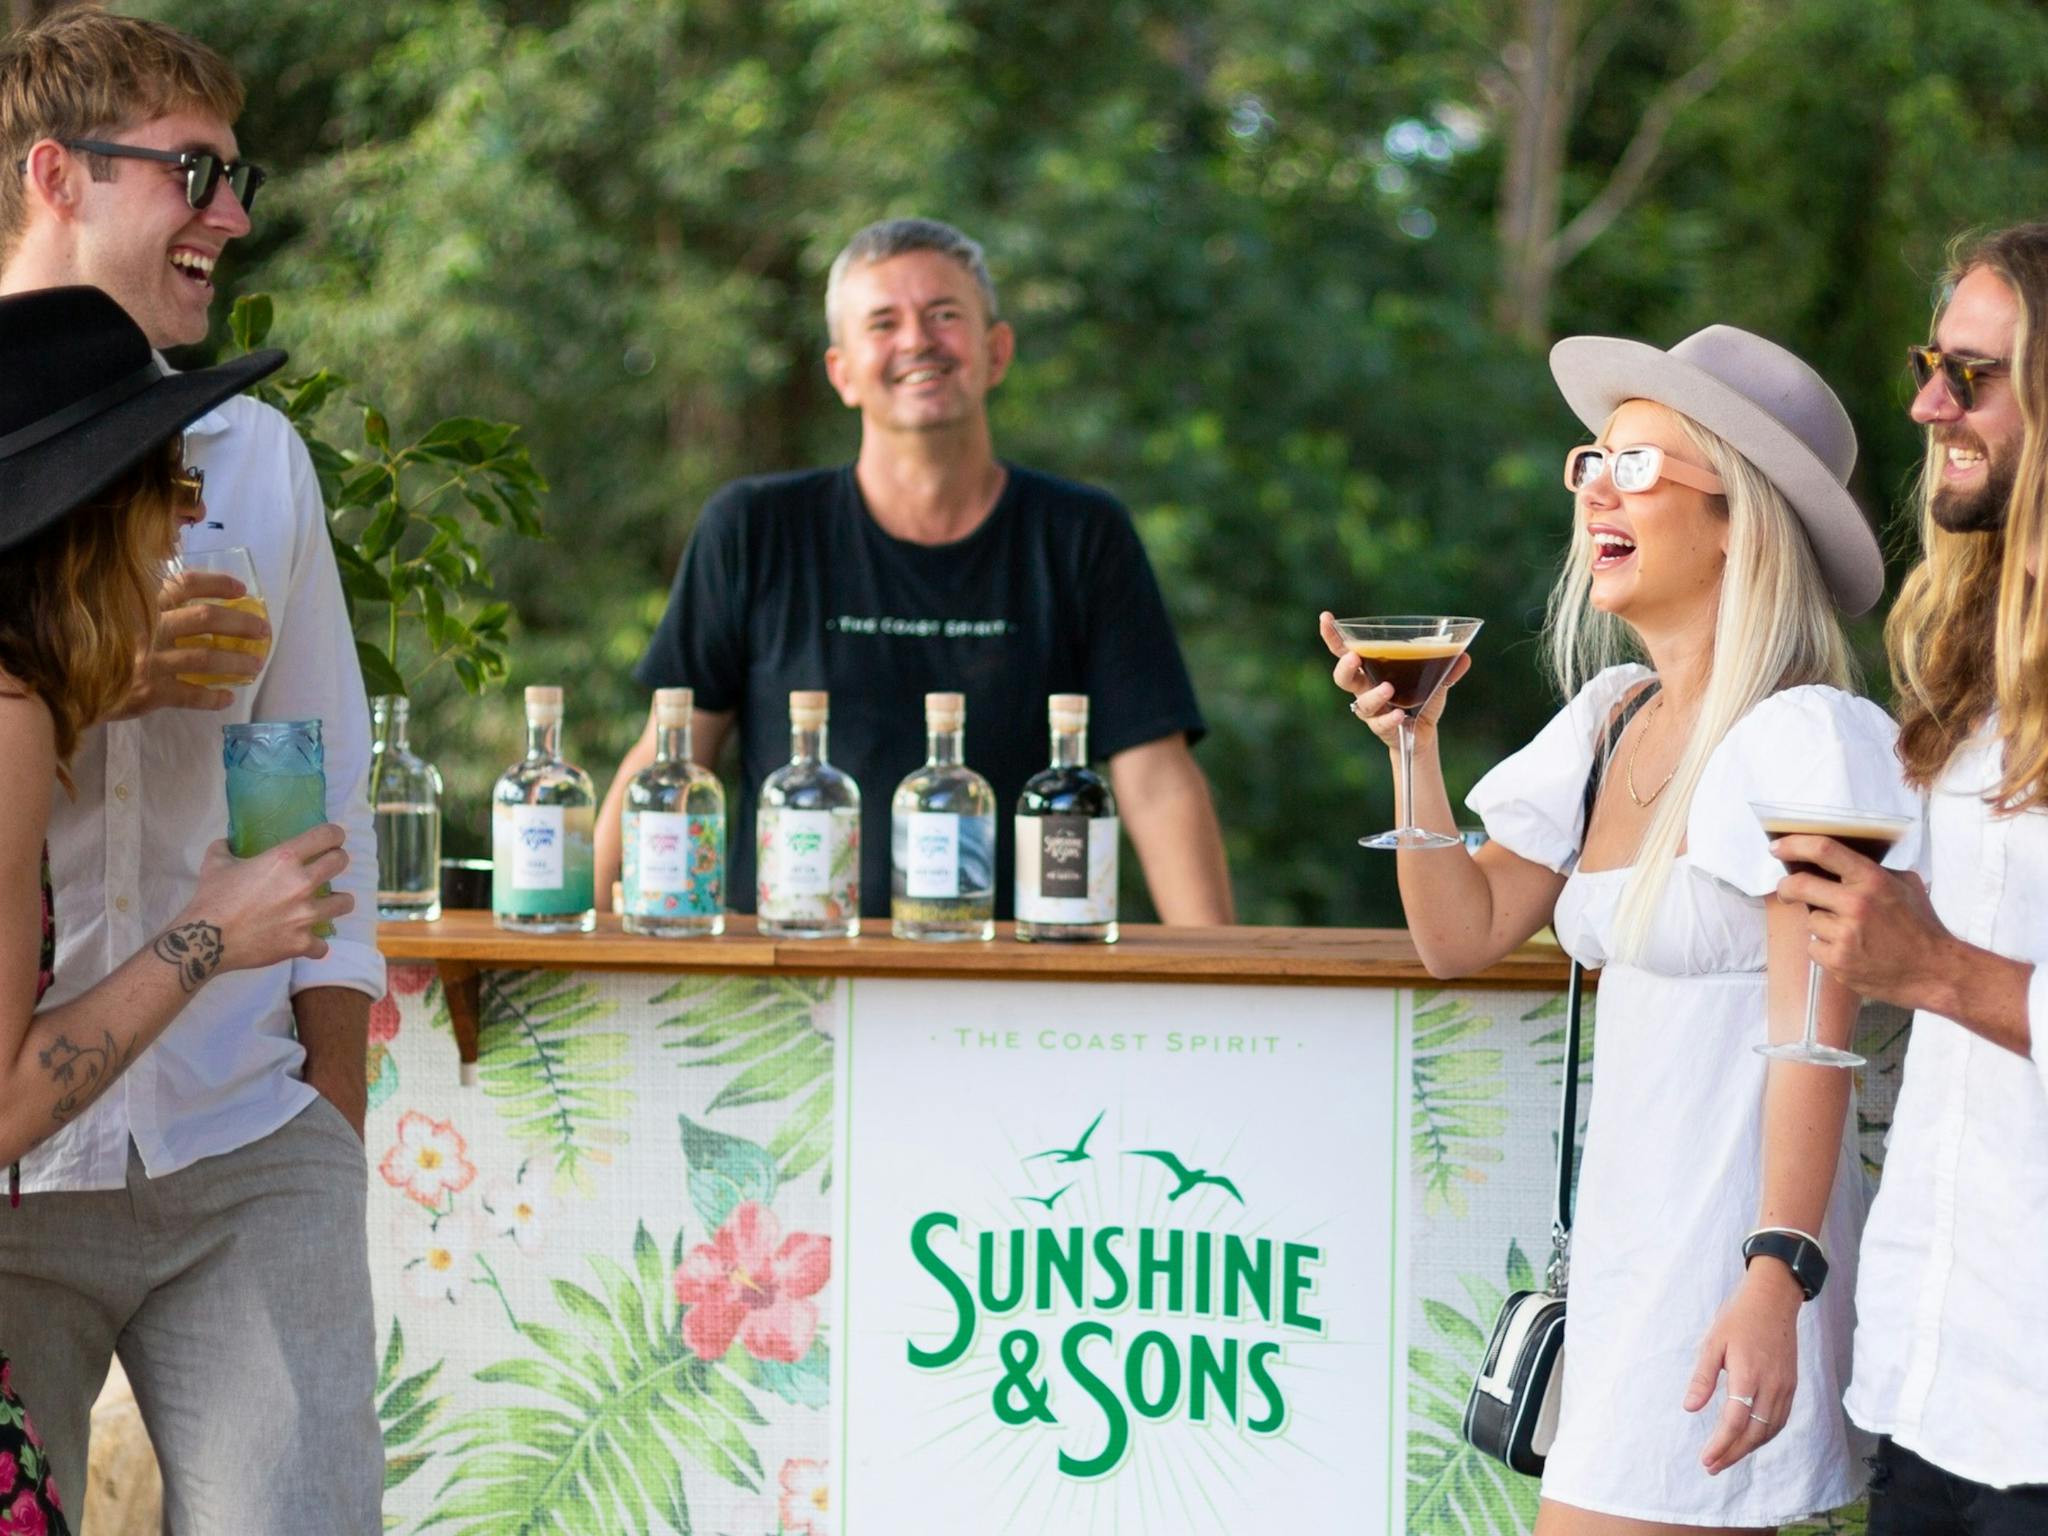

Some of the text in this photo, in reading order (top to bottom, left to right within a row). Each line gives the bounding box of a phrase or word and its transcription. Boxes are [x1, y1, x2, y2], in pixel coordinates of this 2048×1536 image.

[954, 1028, 1281, 1054] THE COAST SPIRIT
[907, 1211, 1323, 1368] SUNSHINE
